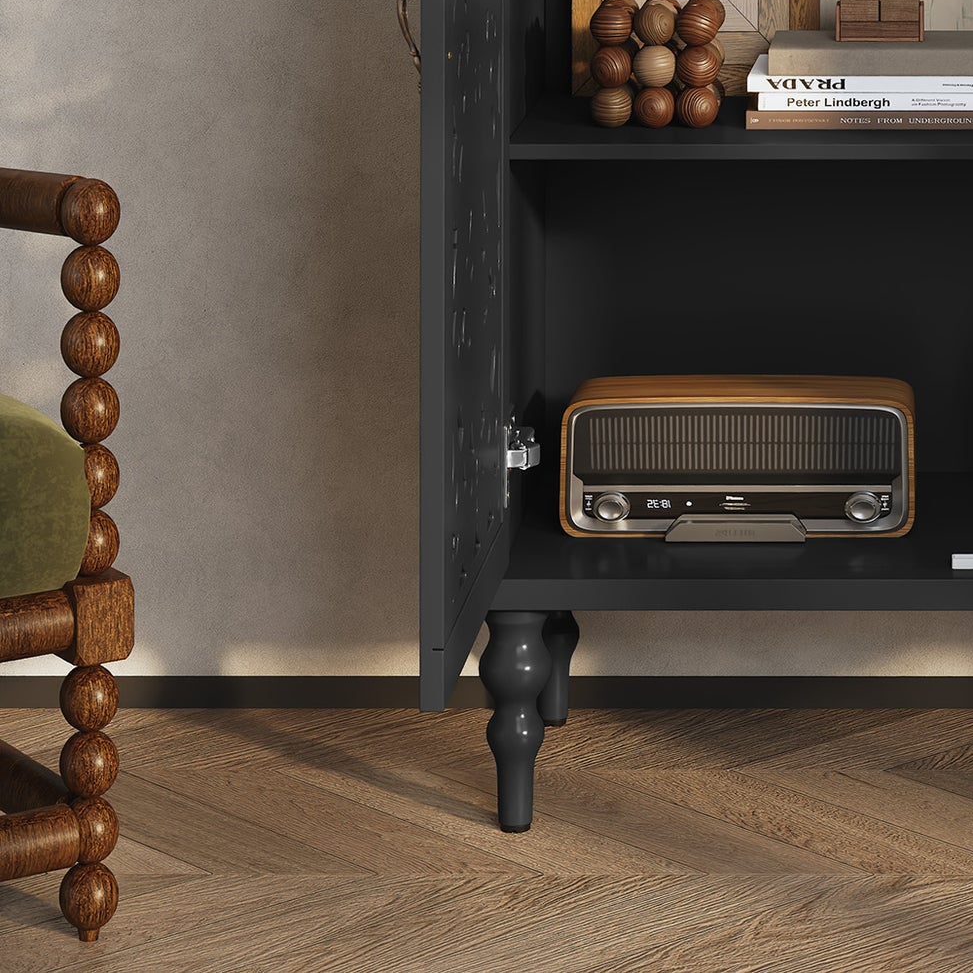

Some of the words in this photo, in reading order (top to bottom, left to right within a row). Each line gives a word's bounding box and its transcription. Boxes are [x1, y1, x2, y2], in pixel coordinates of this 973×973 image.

[766, 78, 846, 91] PRADA
[787, 97, 821, 107] Peter
[824, 97, 891, 110] Lindbergh
